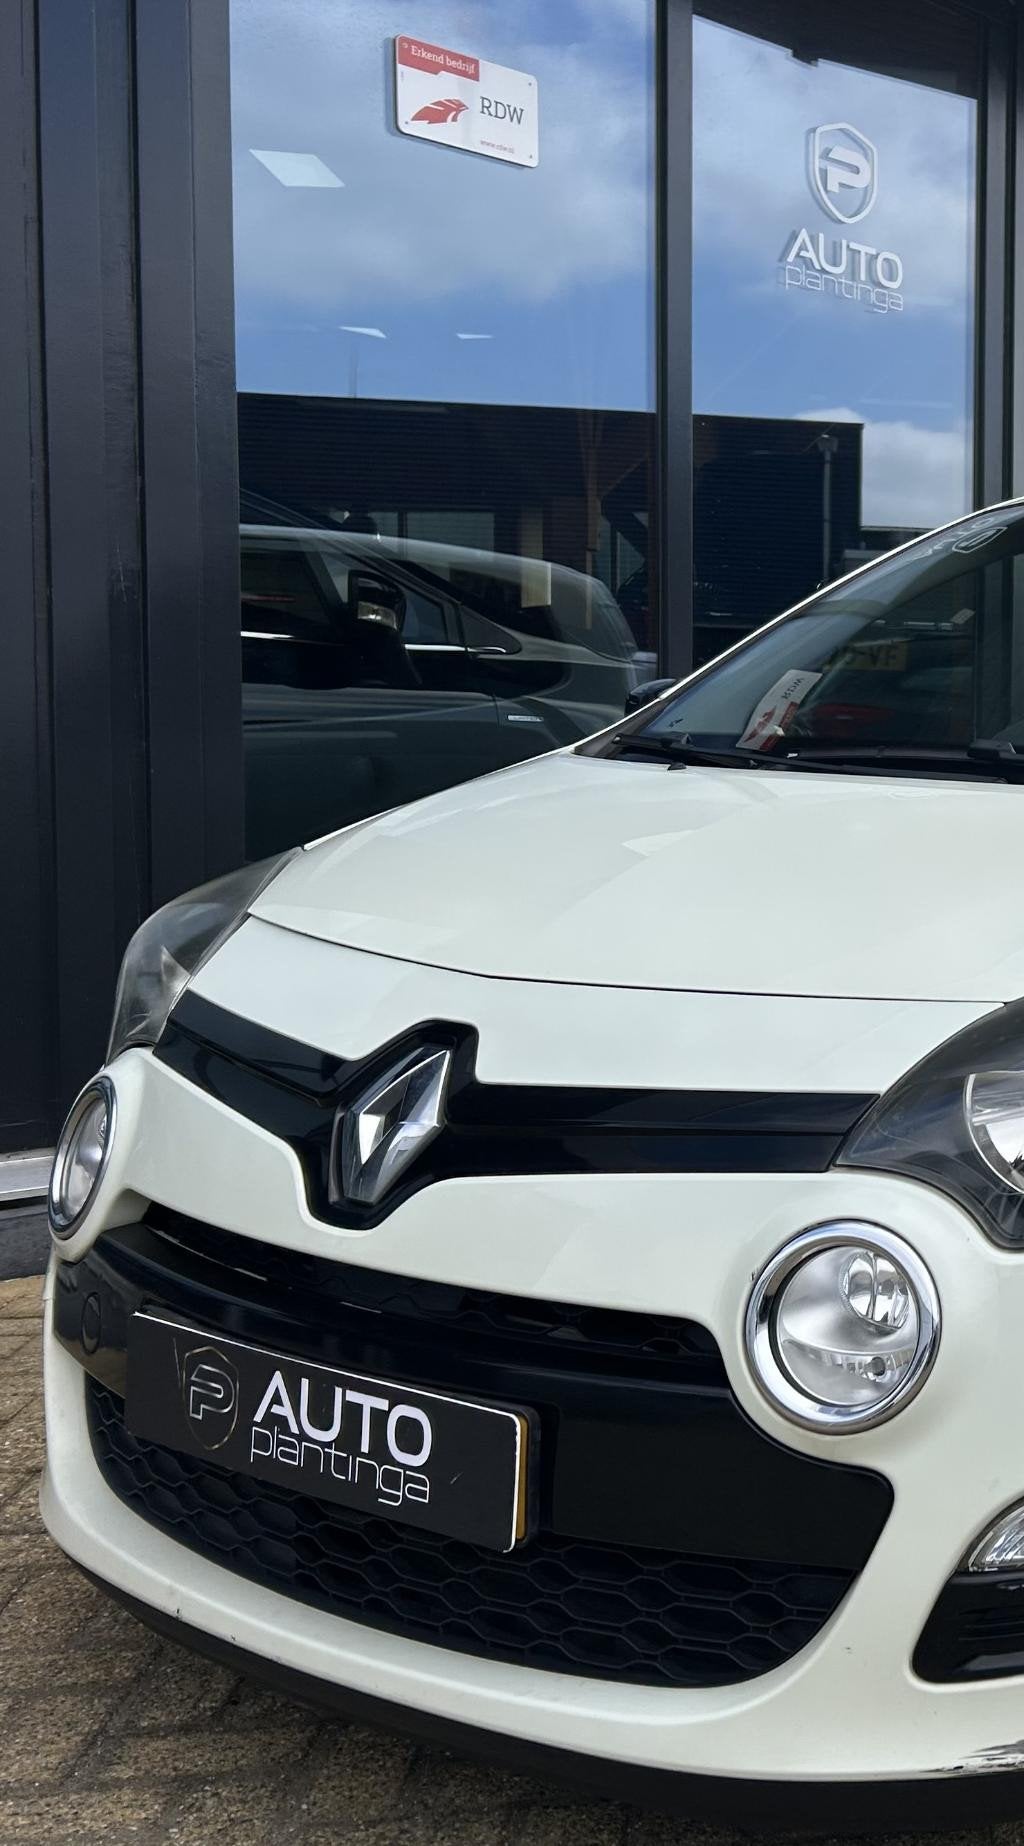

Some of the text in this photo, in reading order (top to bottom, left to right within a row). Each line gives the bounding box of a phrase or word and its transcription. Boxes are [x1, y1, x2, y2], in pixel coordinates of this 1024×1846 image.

[411, 45, 476, 74] Erkend bedrijf
[479, 96, 525, 125] RDW
[787, 228, 903, 289] AUTO
[786, 265, 904, 314] plantinga
[252, 1370, 433, 1467] AUTO
[250, 1425, 430, 1506] plantinga
